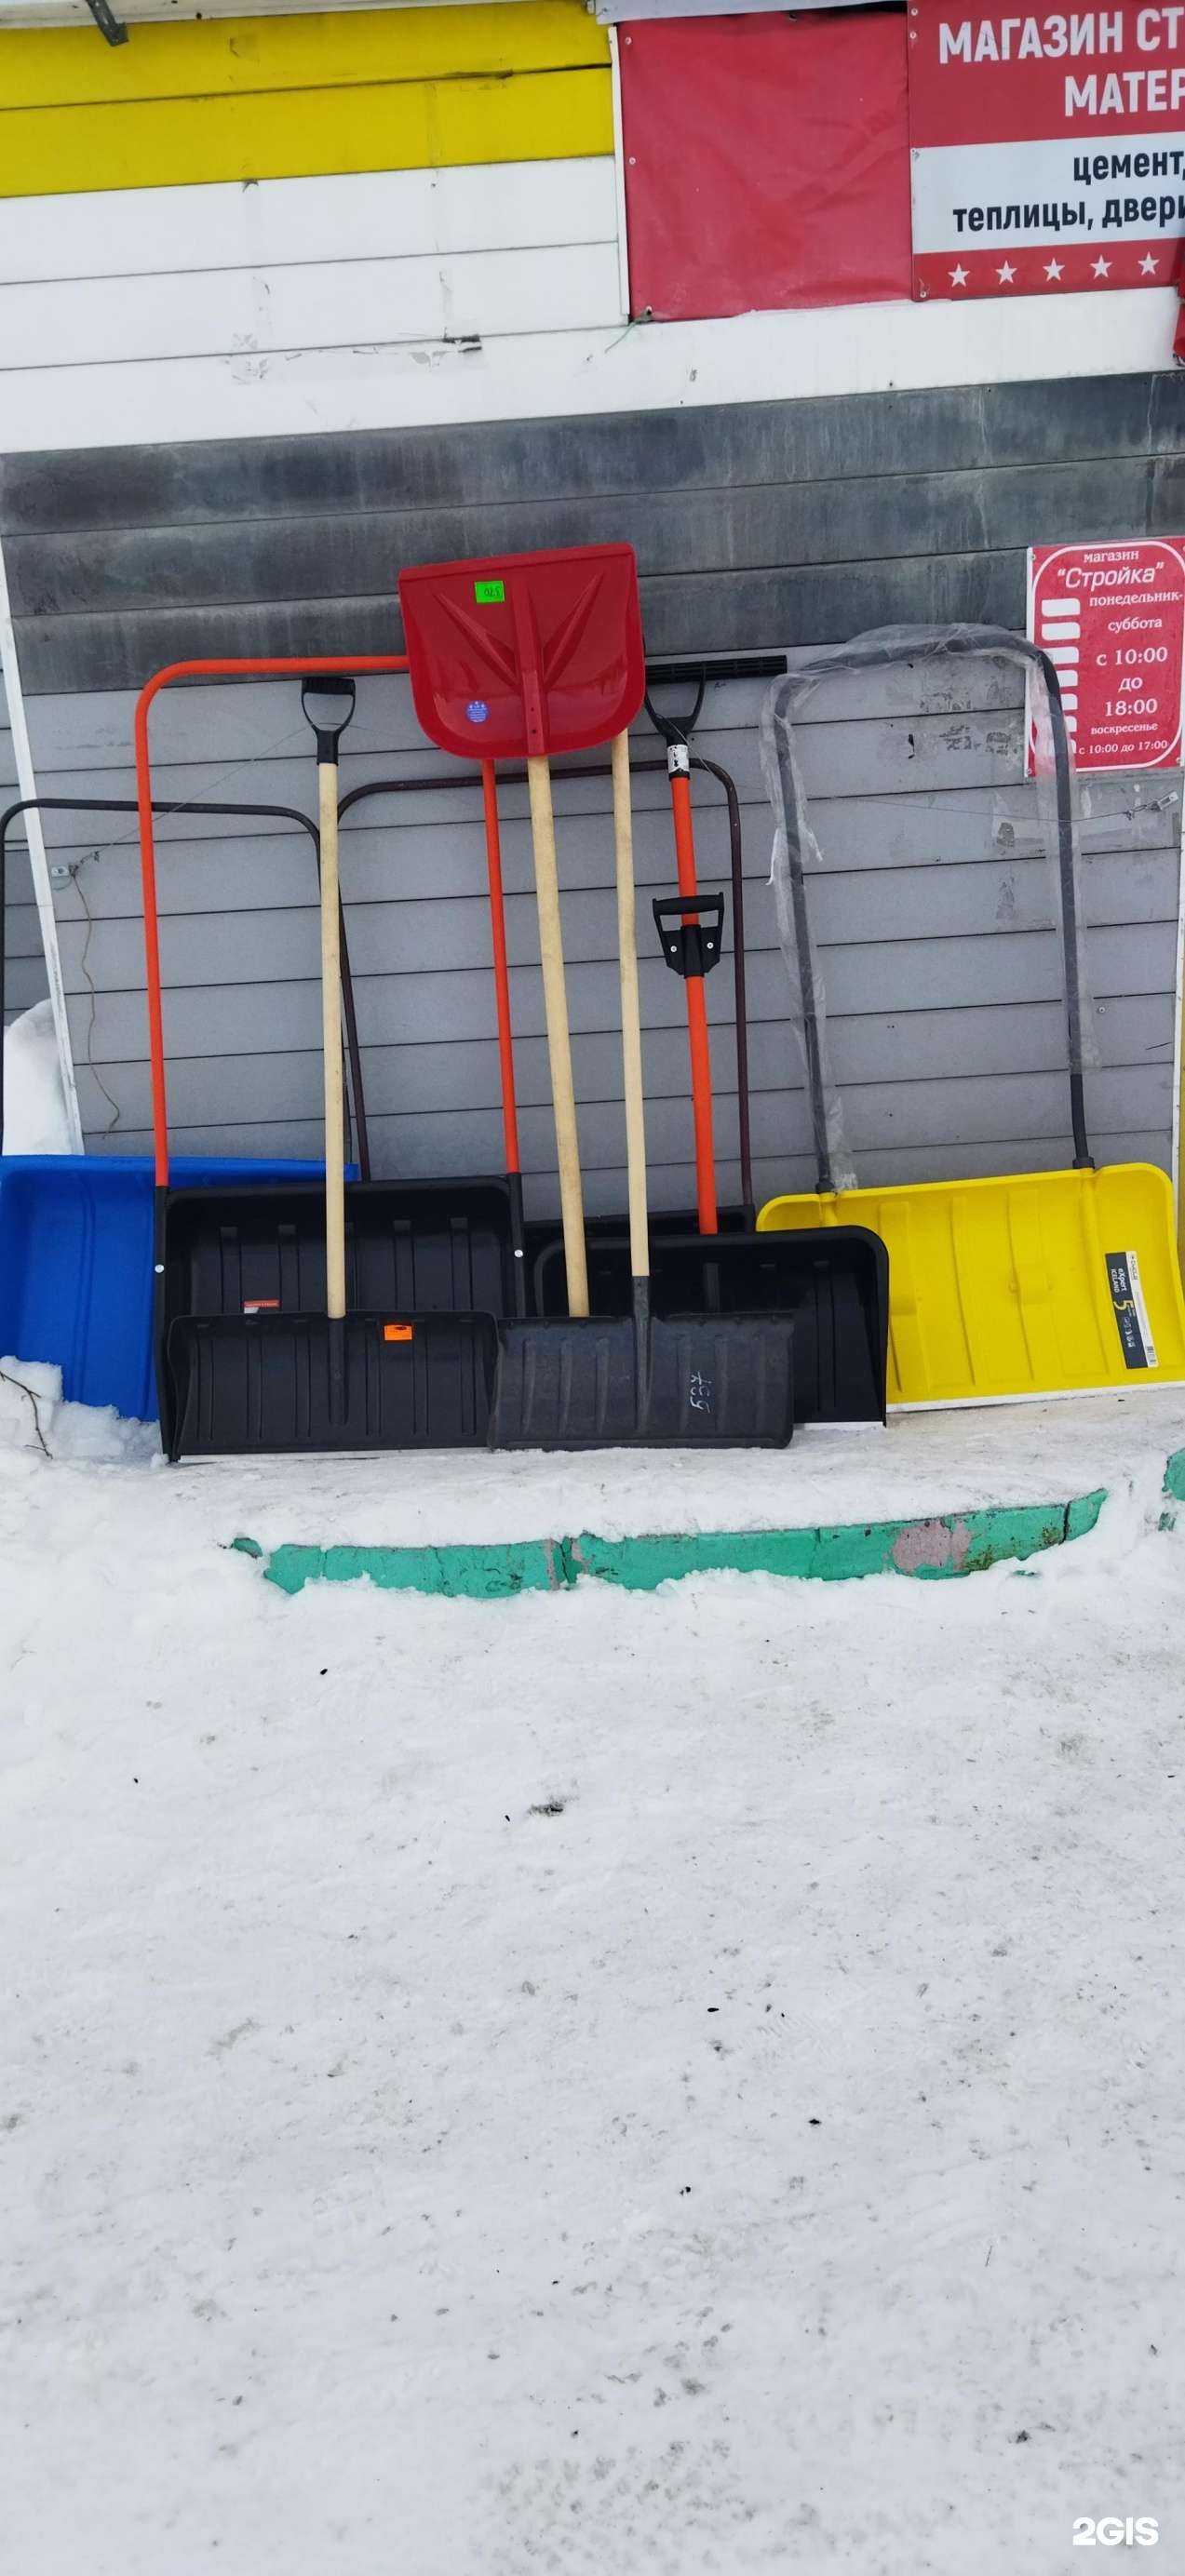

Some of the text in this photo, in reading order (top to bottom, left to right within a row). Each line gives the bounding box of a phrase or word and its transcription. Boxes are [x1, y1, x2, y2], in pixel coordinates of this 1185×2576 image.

[939, 7, 1185, 64] МАГАЗИН СТ
[1064, 68, 1185, 117] МАТЕР
[953, 201, 1094, 233] теплицы,
[1084, 550, 1139, 563] магазин
[1089, 591, 1183, 608] понедельник-
[1108, 617, 1163, 634] суббота
[1096, 647, 1168, 666] с 10:00
[1118, 677, 1144, 693] до
[1104, 698, 1158, 717] 18:00
[1090, 721, 1159, 736] воскресенье
[1089, 744, 1118, 754] 10:00
[1121, 744, 1136, 753] до
[1138, 740, 1168, 751] 17:00
